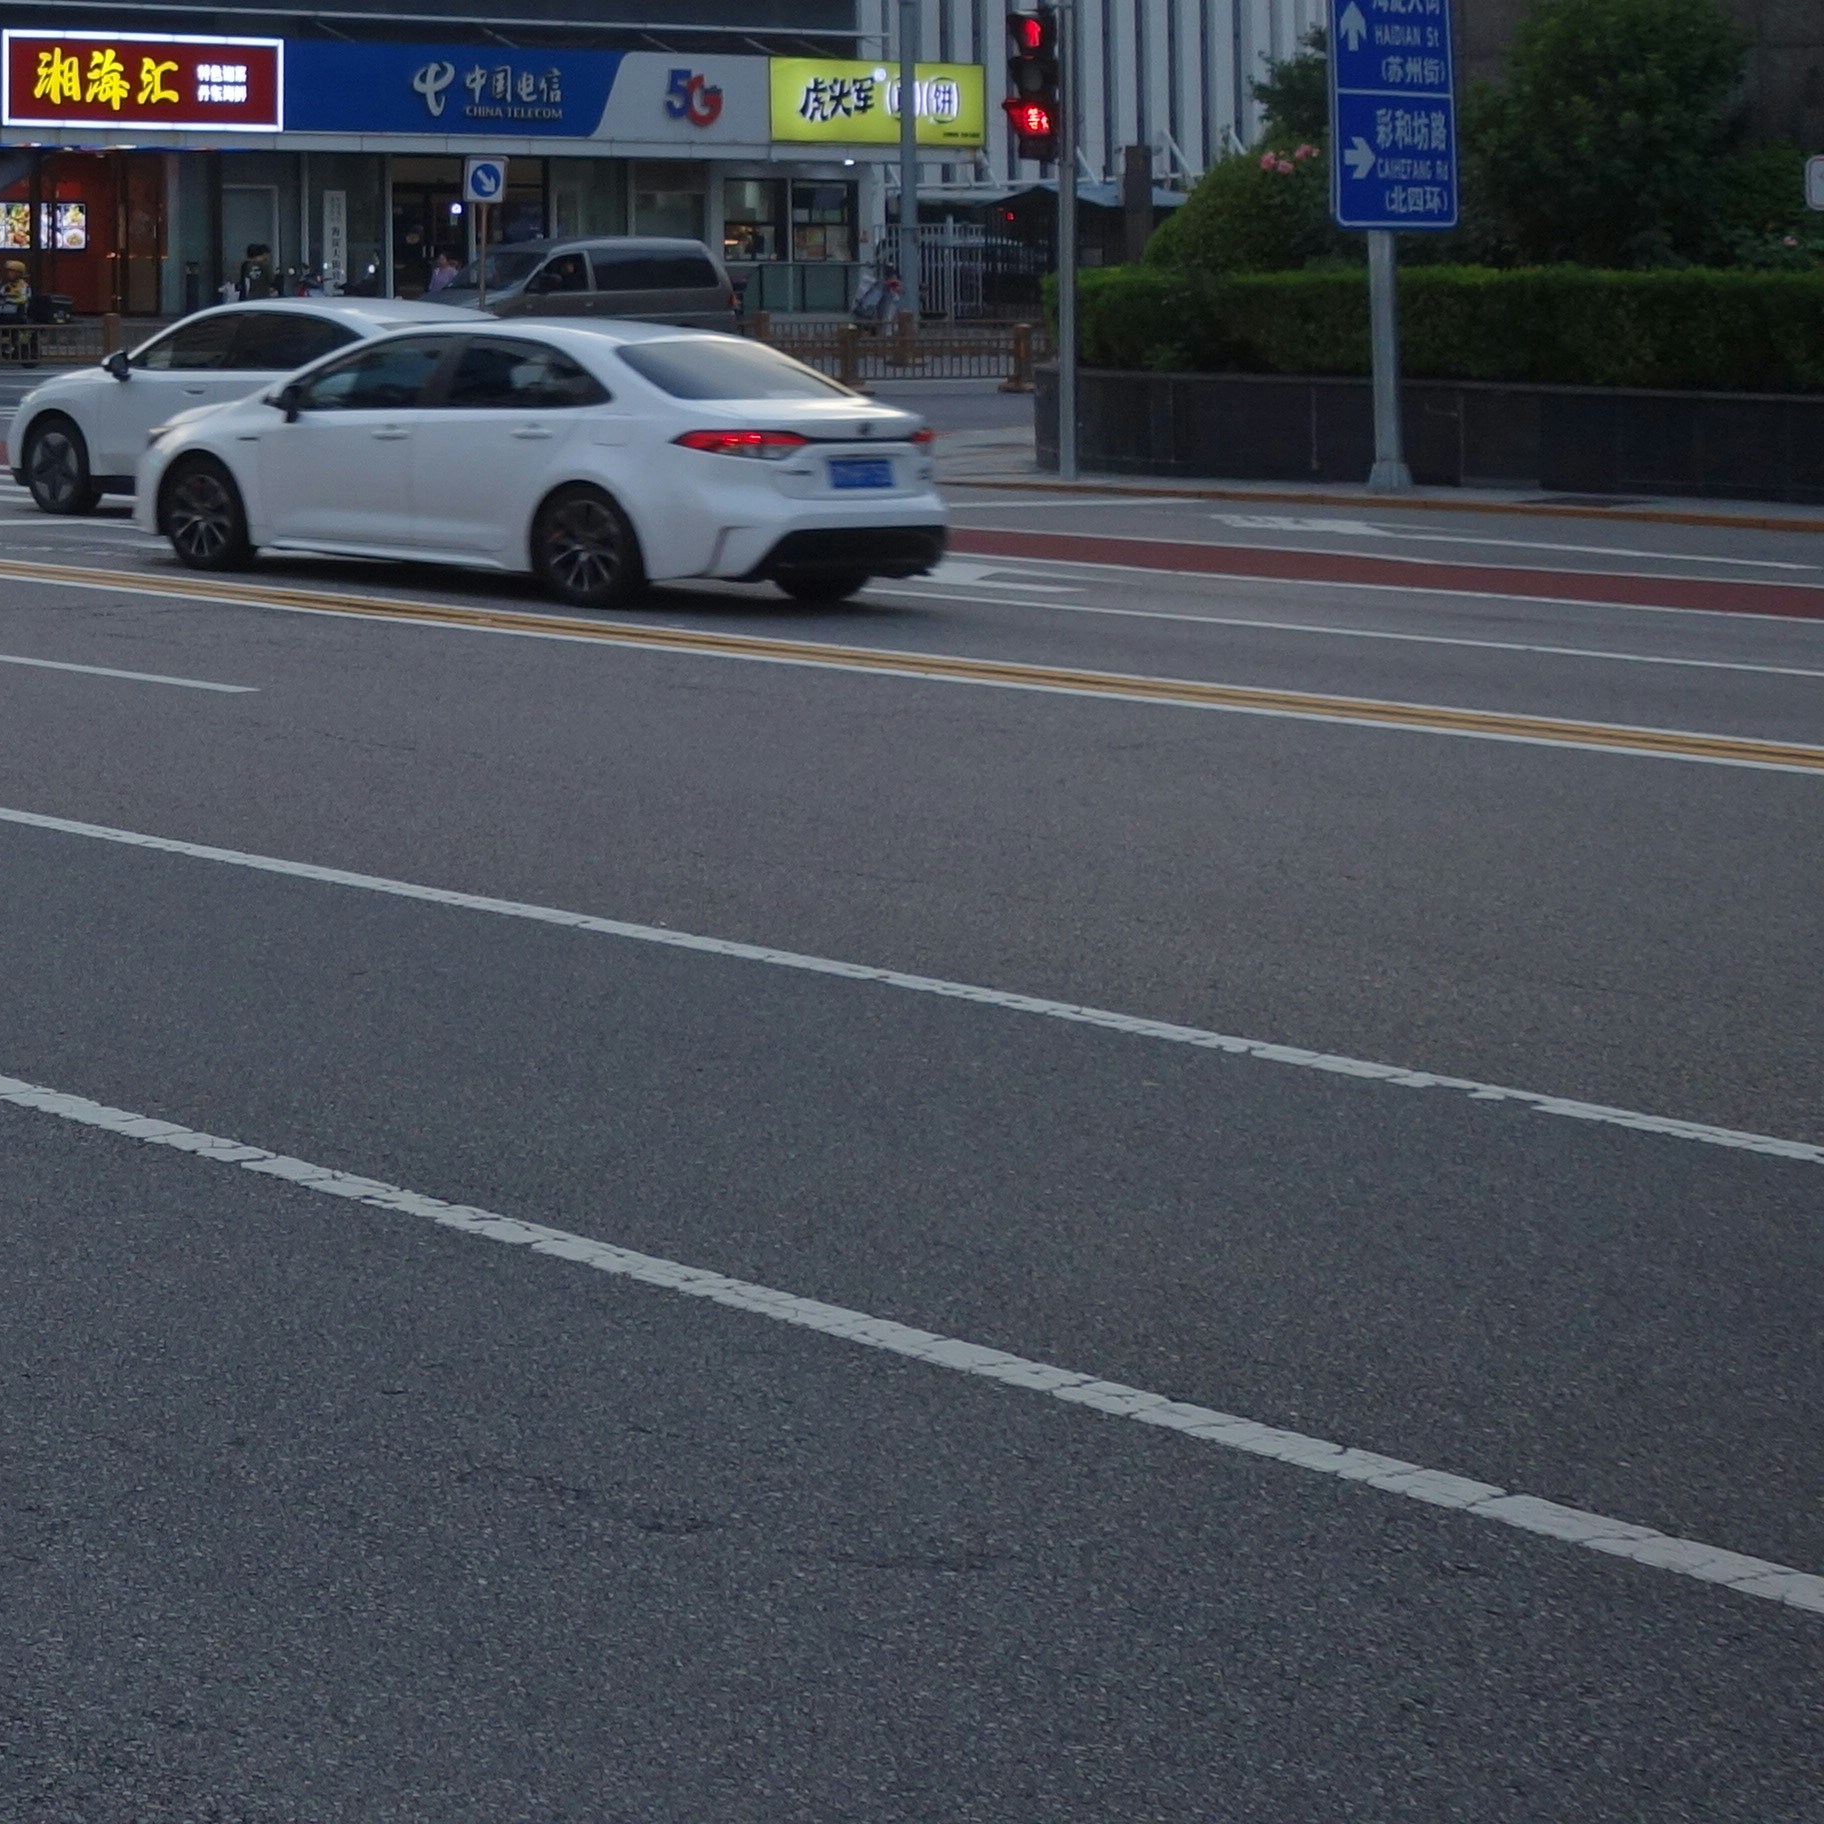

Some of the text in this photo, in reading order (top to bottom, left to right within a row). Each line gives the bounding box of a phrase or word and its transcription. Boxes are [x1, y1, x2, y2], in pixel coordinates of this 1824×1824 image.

[1375, 25, 1421, 46] HAIDIAN
[34, 47, 179, 110] 湘海汇
[466, 64, 562, 104] 中国电信
[1381, 55, 1445, 85] (苏州街)
[465, 106, 563, 119] CHINA TELECOM
[664, 69, 724, 126] 5G
[799, 76, 875, 124] 虎头军
[1376, 108, 1447, 151] 彩和坊路
[1377, 158, 1432, 180] CAIHEFANG
[1385, 185, 1449, 214] (北四环)
